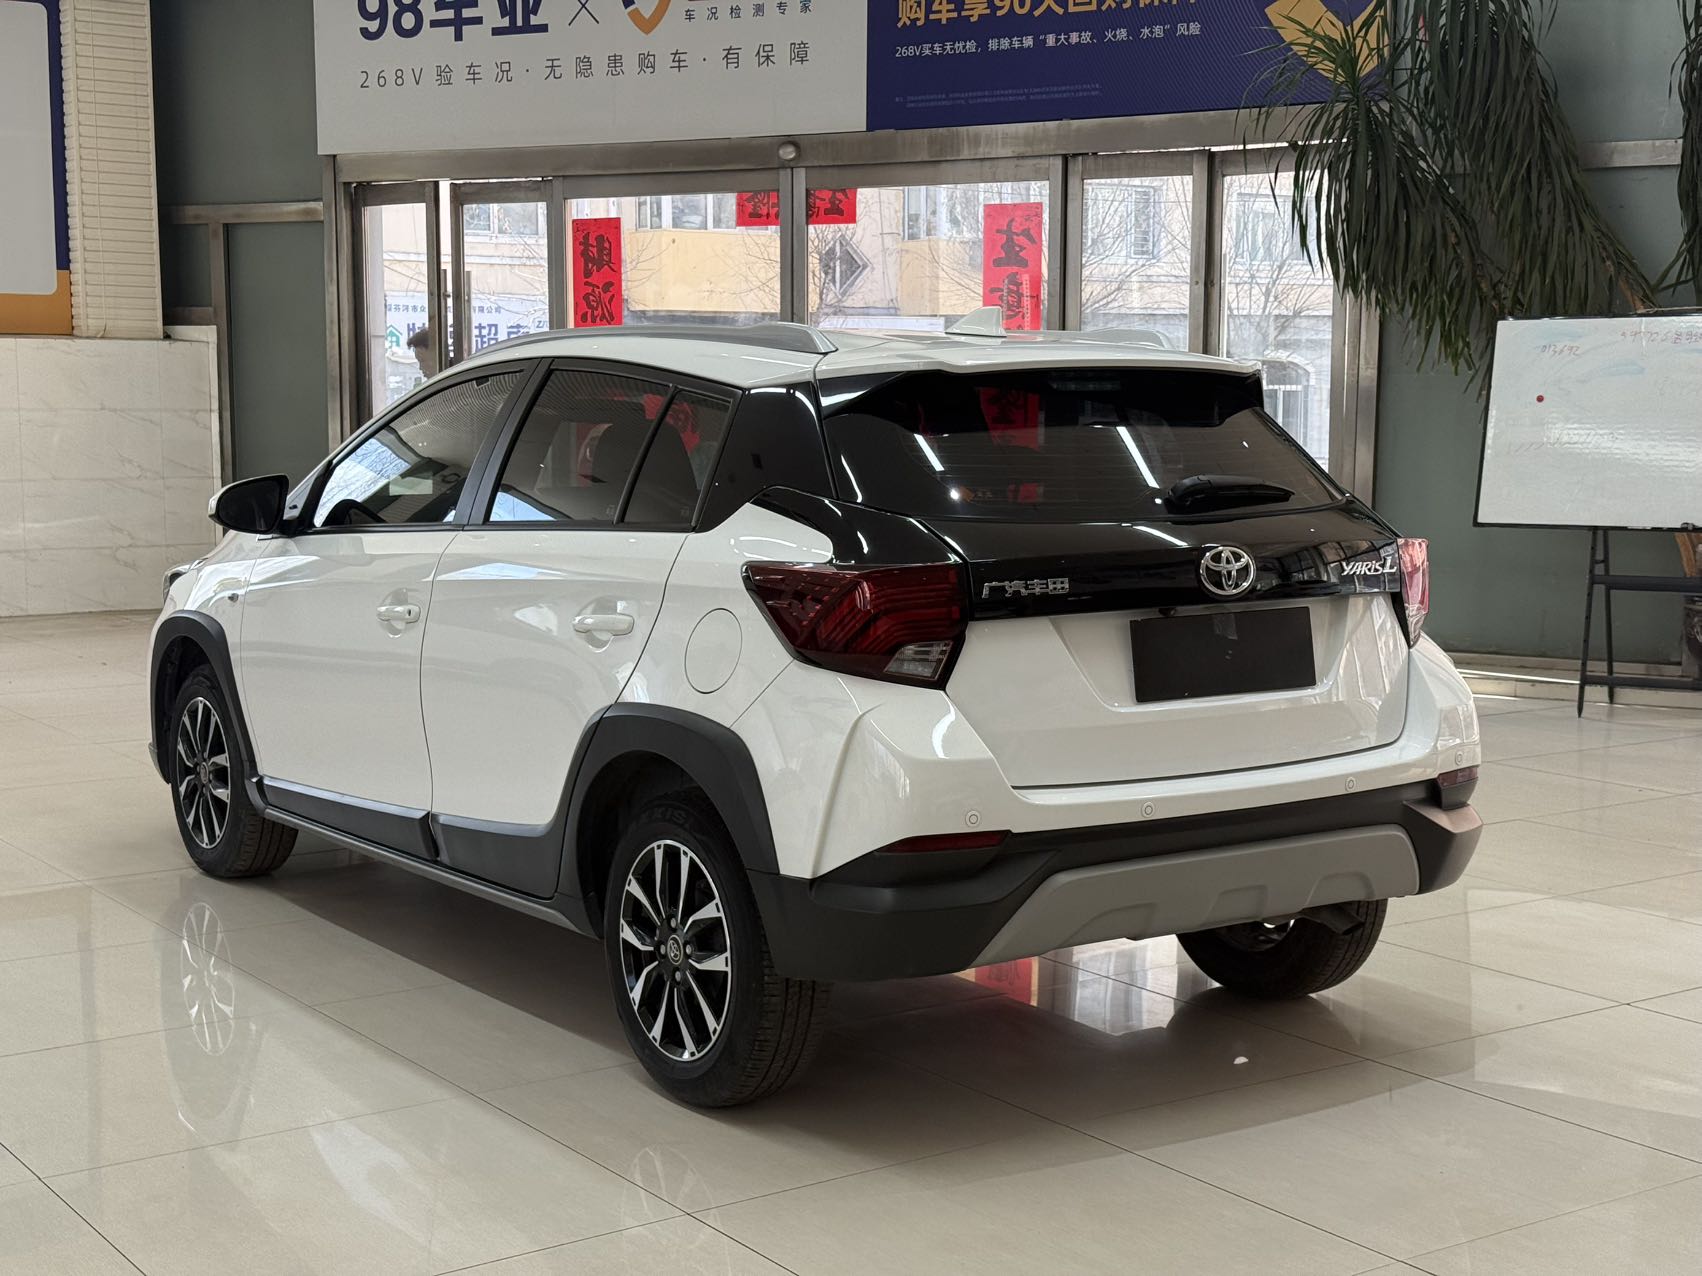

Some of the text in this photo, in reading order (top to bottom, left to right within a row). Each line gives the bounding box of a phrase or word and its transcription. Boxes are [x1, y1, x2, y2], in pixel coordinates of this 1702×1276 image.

[684, 0, 813, 22] 车况检测专家
